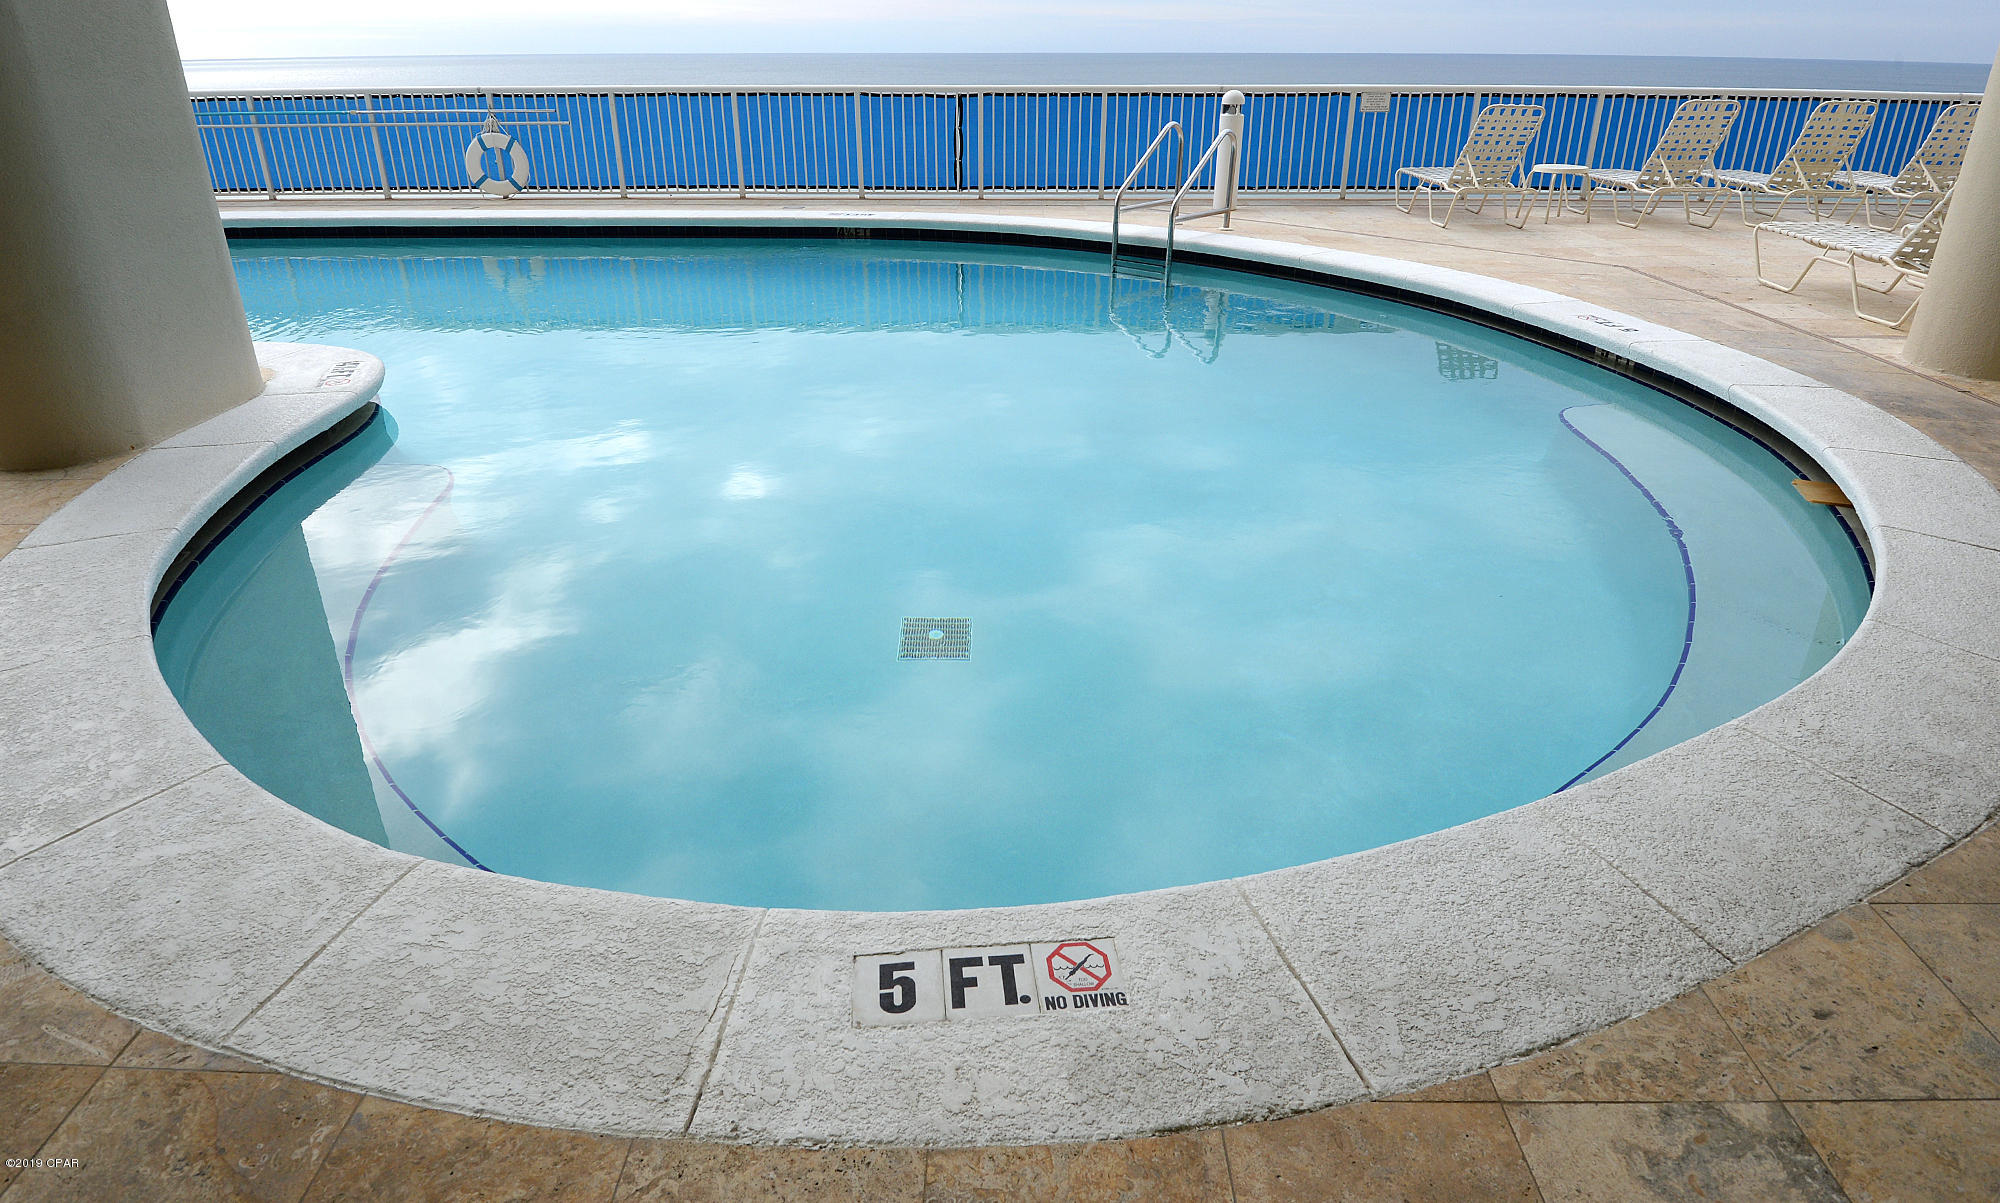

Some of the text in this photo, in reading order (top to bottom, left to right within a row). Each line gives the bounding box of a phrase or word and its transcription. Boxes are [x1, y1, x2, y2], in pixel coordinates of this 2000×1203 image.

[879, 953, 1032, 1014] 5 FT.
[1044, 991, 1129, 1010] NO DIVING
